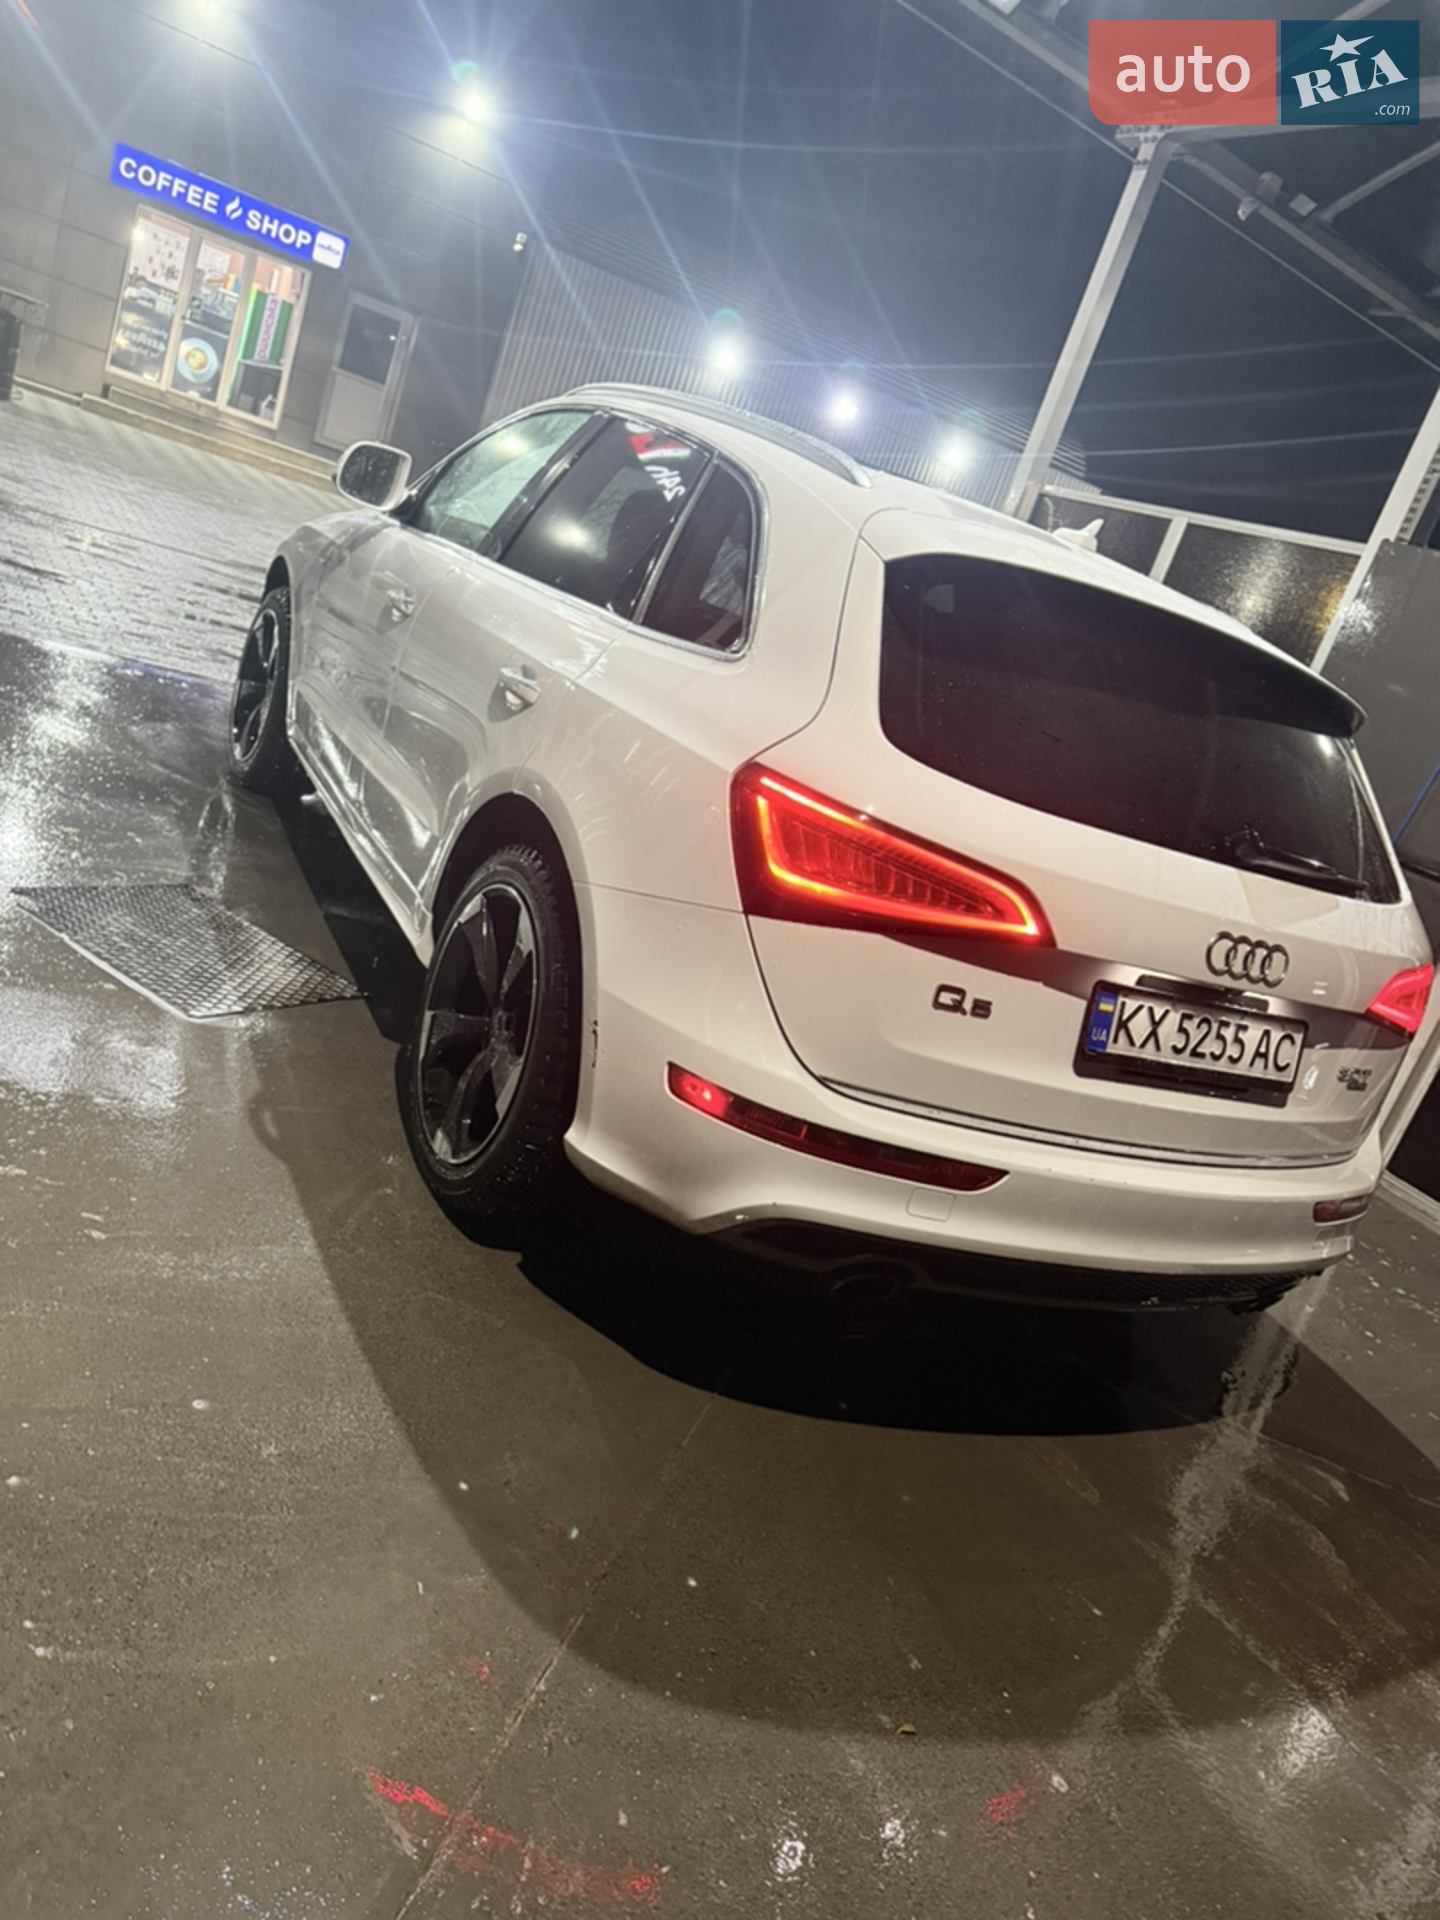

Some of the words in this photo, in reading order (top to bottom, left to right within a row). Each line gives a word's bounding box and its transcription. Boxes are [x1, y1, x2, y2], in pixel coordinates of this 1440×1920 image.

[118, 157, 219, 213] COFFEE
[245, 209, 312, 249] SHOP
[932, 983, 993, 1020] Q5
[1090, 1027, 1108, 1043] UA
[1112, 1000, 1171, 1052] KX
[1170, 1011, 1249, 1065] 5255
[1249, 1028, 1296, 1073] AC
